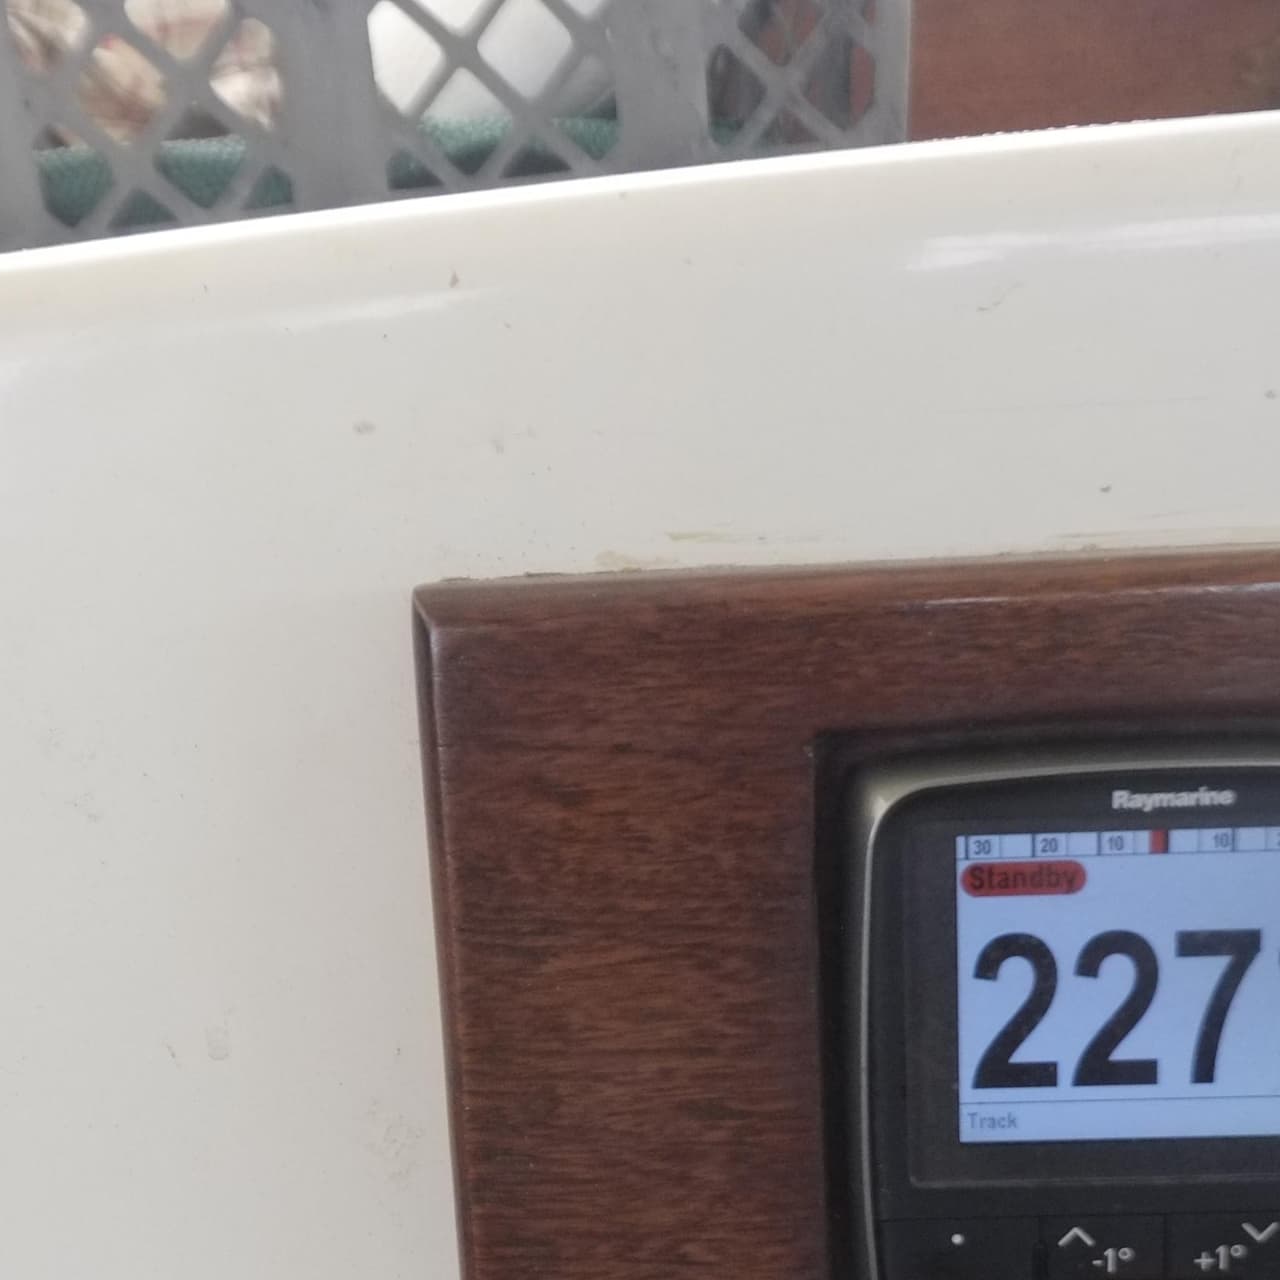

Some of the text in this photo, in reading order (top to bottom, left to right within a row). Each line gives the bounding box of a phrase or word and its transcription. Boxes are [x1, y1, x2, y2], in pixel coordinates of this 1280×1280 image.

[1111, 788, 1234, 811] Raymarine
[973, 837, 992, 856] 30
[1040, 834, 1059, 854] 20
[1107, 833, 1125, 851] 10
[1213, 831, 1231, 848] 10
[967, 865, 1079, 894] Standby
[967, 1112, 1018, 1131] Track
